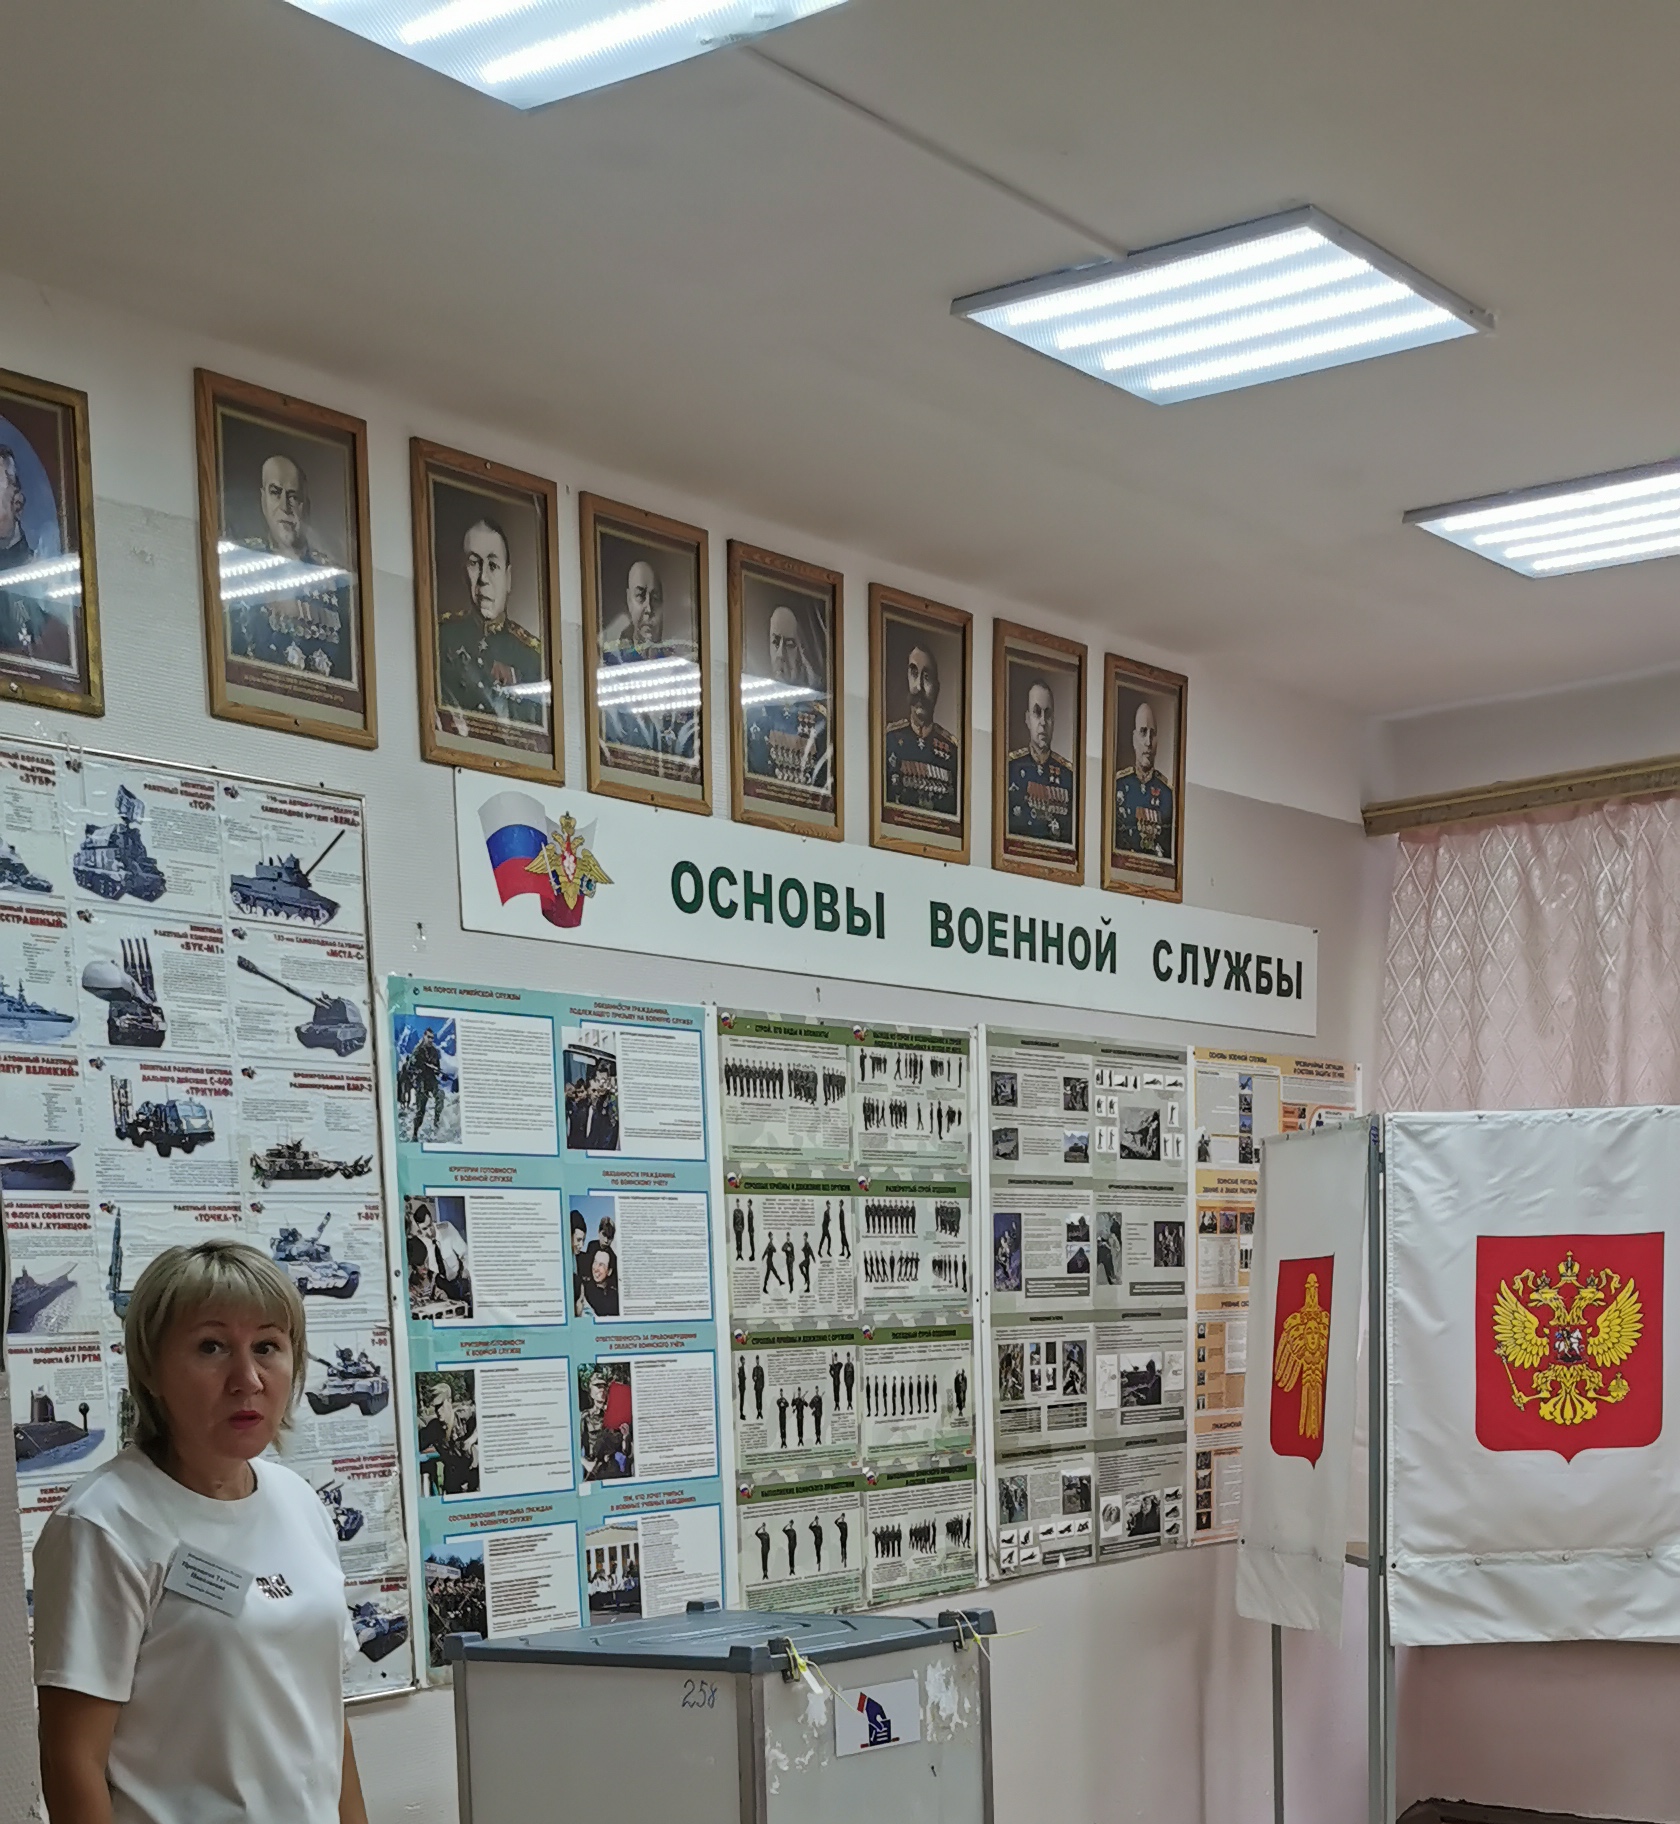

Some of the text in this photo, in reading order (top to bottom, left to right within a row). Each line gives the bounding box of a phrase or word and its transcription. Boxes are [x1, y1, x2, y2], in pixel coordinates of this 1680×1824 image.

[671, 861, 1303, 1000] ОСНОВЫ ВОЕННОЙ СЛУЖБЫ
